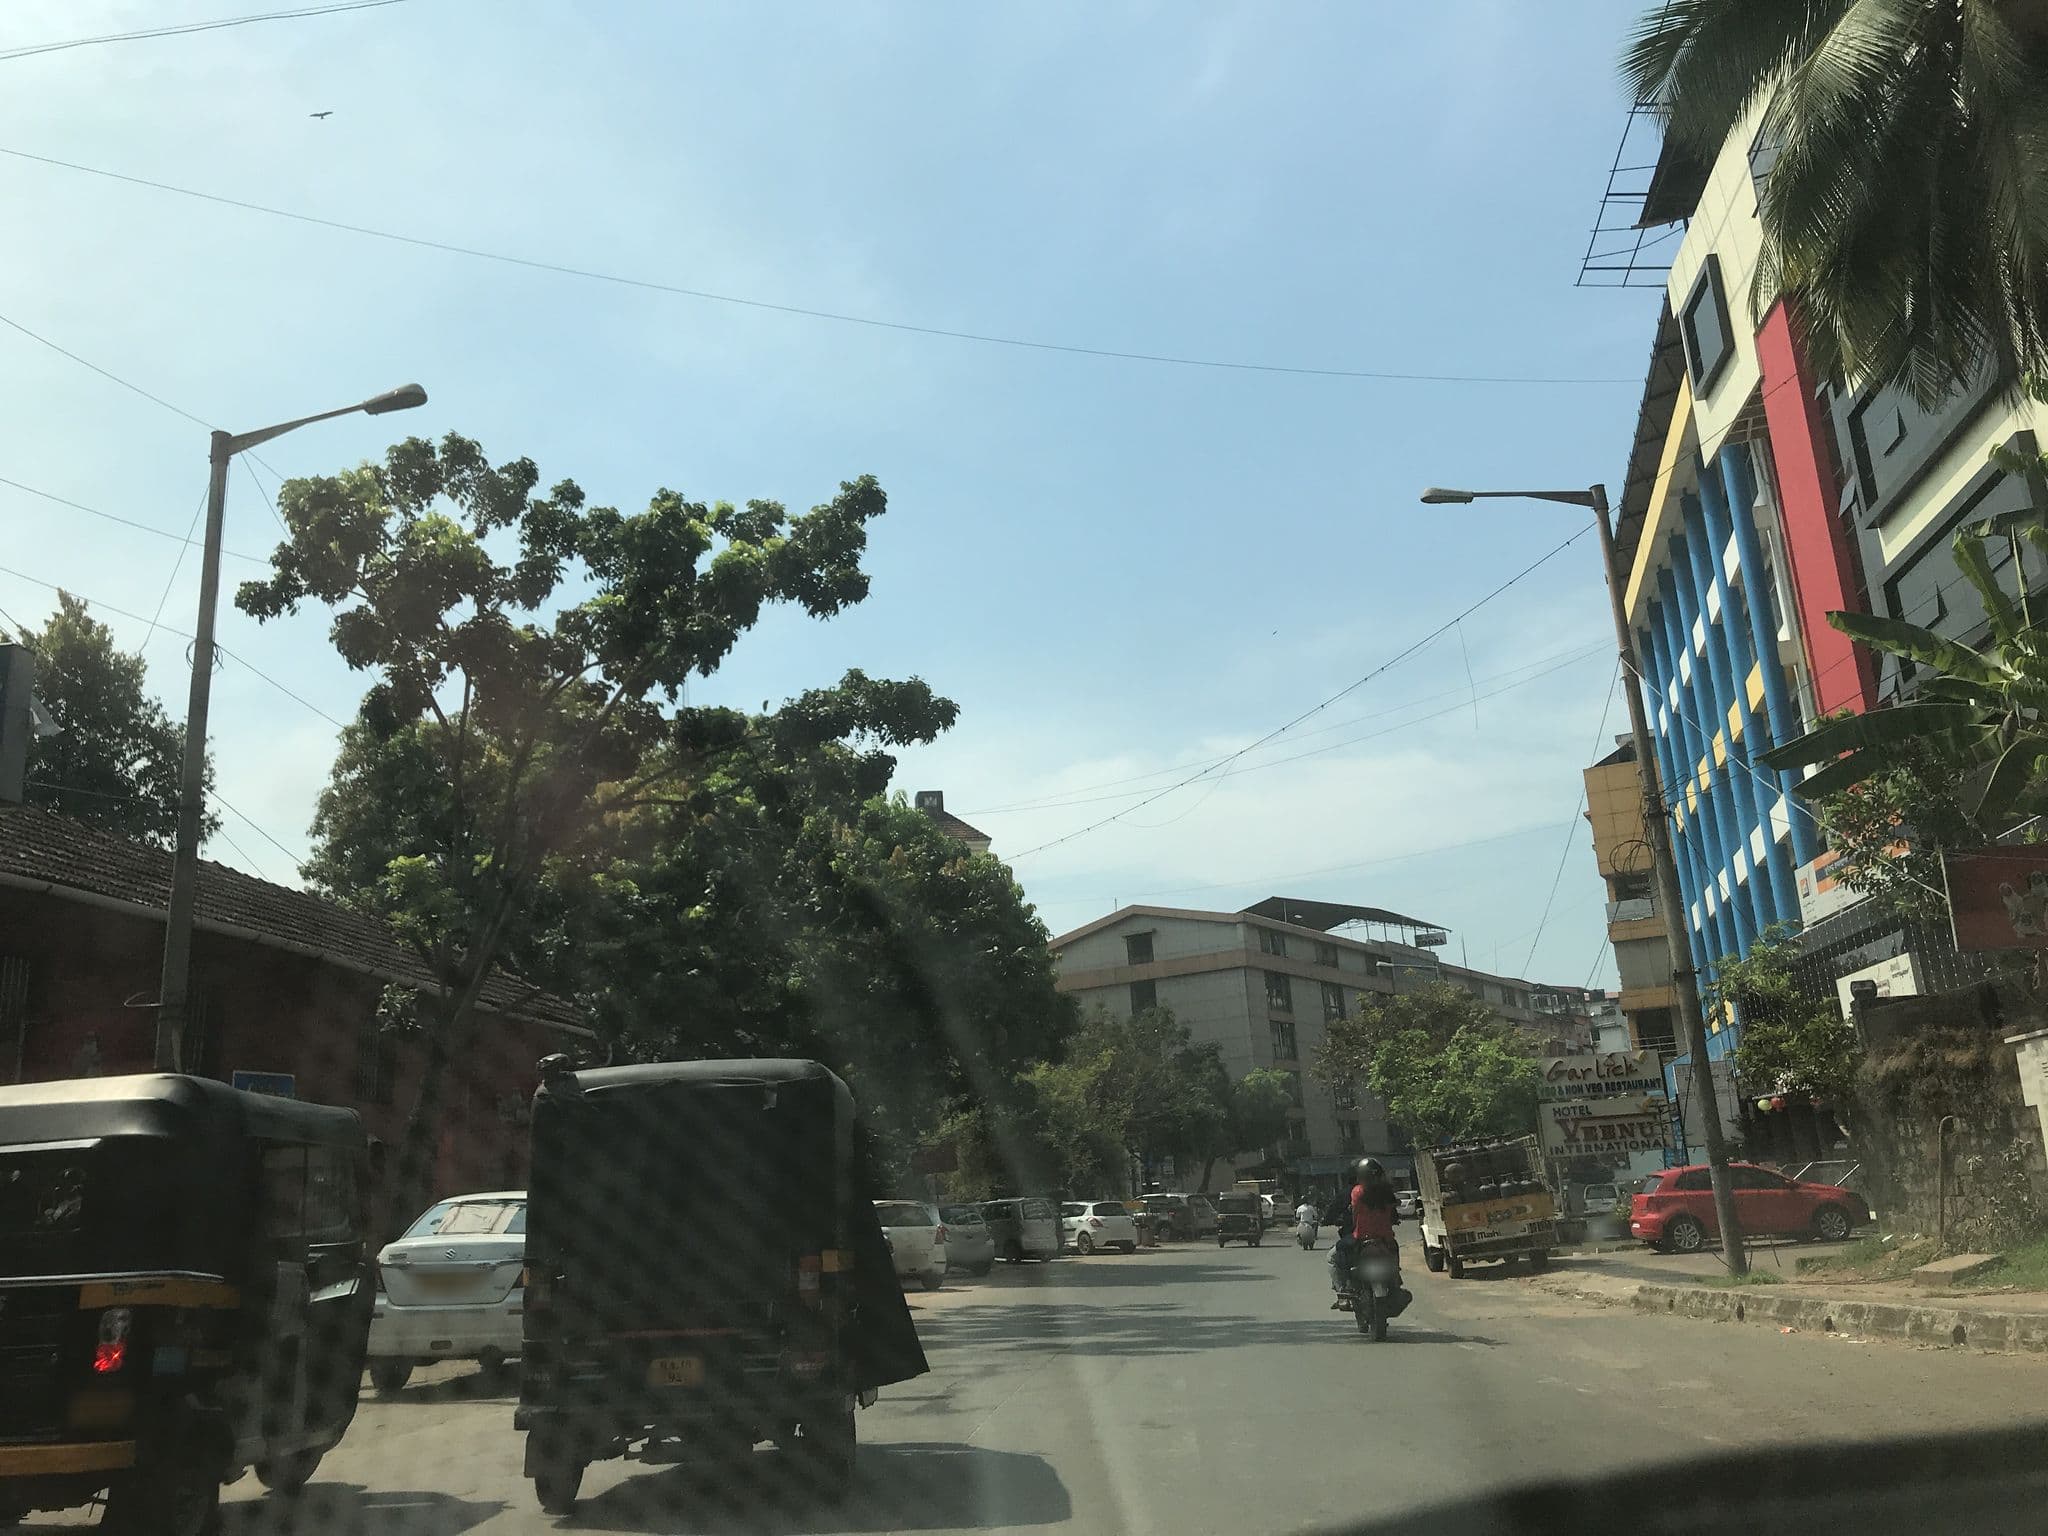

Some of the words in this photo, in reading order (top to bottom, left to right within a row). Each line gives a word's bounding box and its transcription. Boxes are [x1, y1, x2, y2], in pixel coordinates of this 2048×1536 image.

[1565, 1084, 1584, 1095] NON
[1585, 1081, 1603, 1094] VEG
[1605, 1077, 1661, 1093] RESTAURANT
[1552, 1104, 1593, 1117] HOTEL
